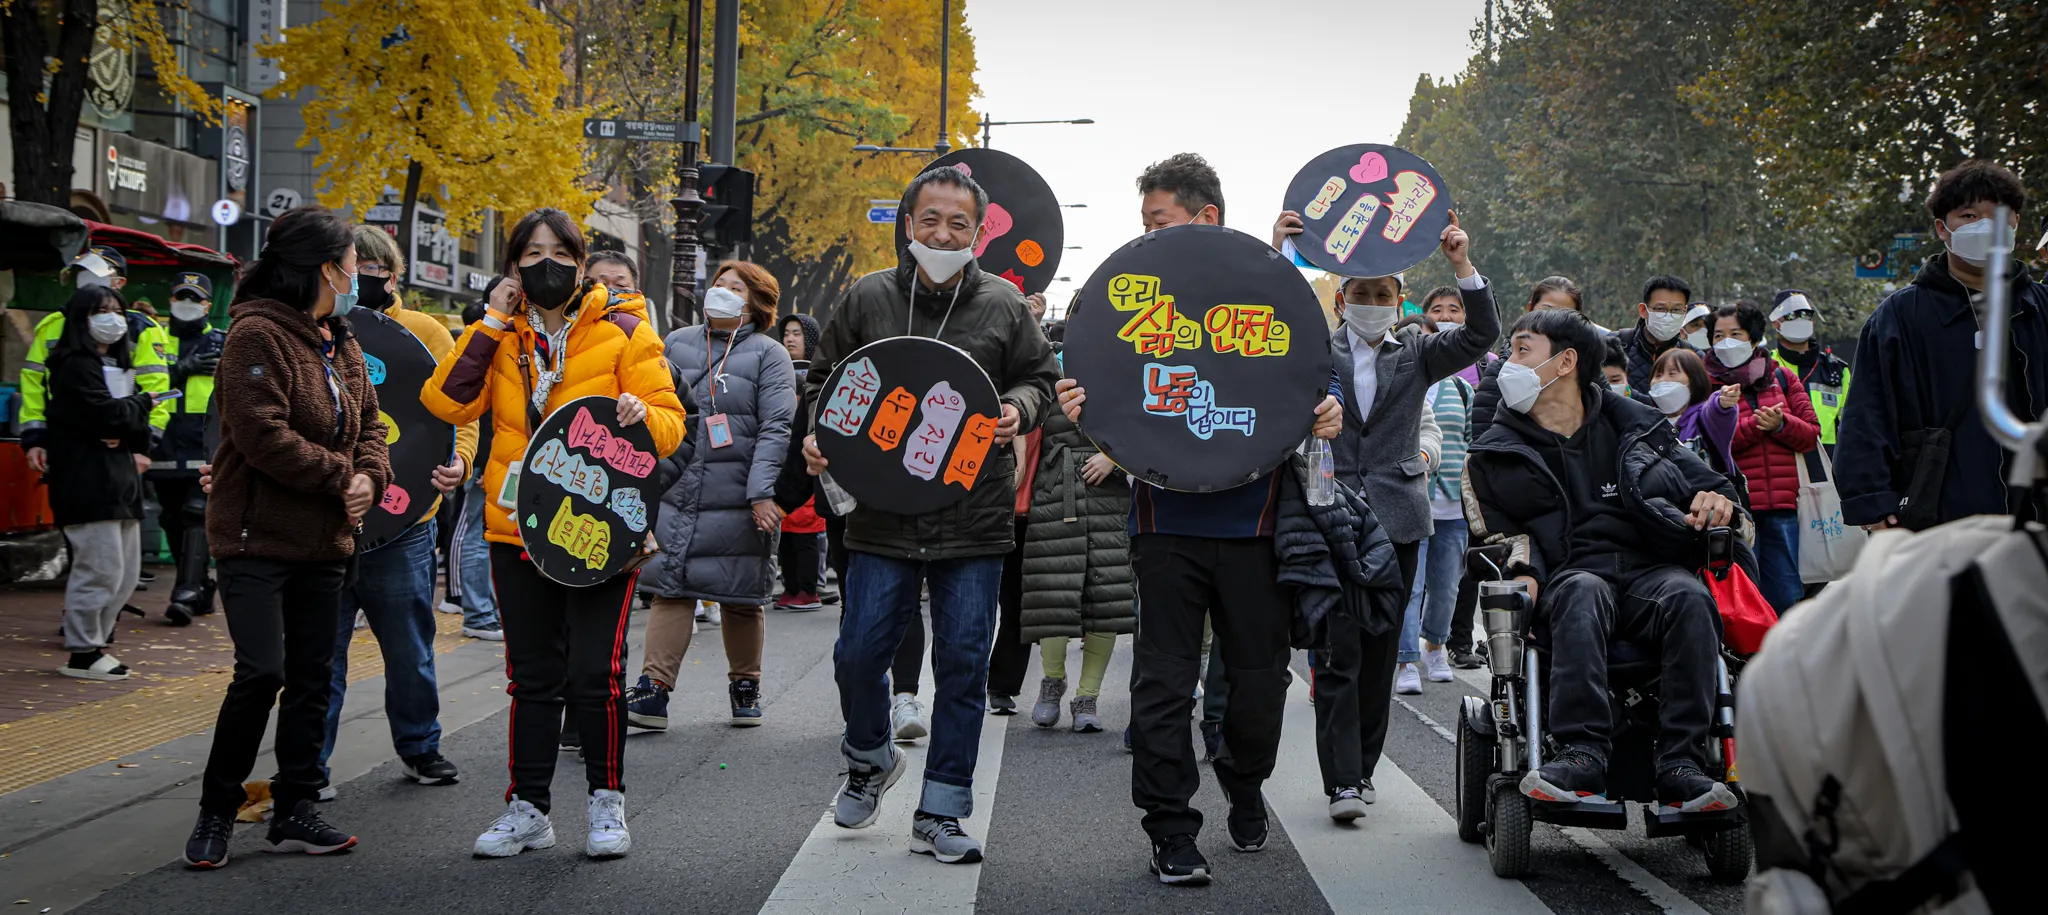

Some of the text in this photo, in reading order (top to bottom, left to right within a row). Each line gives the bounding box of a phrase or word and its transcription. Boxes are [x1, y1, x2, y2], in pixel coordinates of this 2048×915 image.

[270, 194, 293, 210] 21
[1312, 181, 1343, 213] 나의
[1331, 202, 1376, 253] 노동권을
[1113, 276, 1286, 356] 우리 삶의 안전은
[825, 359, 910, 444] 나의 생존권
[1146, 367, 1209, 413] 노동이
[908, 395, 990, 476] 나의 일자리
[1188, 402, 1255, 435] 답이다
